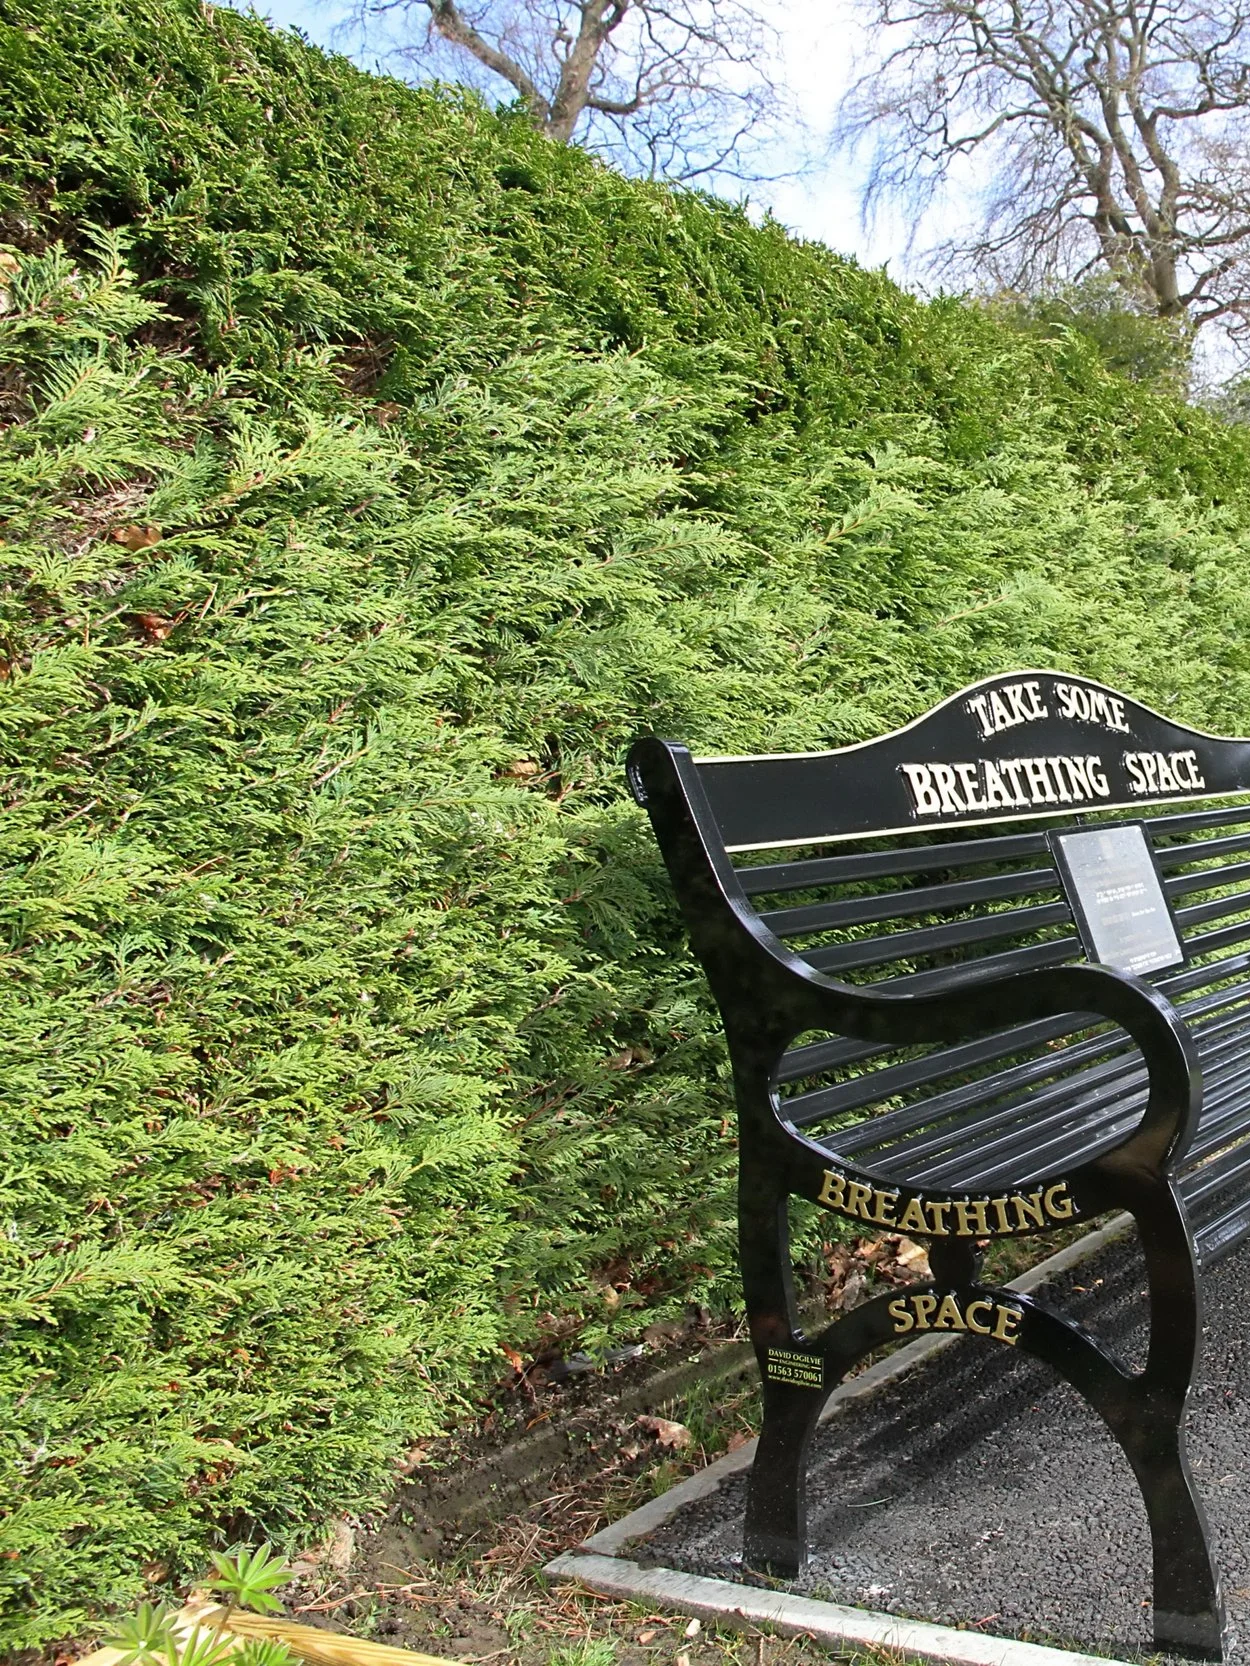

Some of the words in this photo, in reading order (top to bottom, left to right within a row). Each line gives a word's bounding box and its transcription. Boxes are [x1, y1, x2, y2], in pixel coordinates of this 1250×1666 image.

[968, 681, 1049, 738] TAKE
[1053, 682, 1130, 734] SOME
[901, 755, 1111, 815] BREATHING
[1123, 750, 1206, 793] SPACE
[818, 1169, 1074, 1236] BREATHING
[888, 1295, 1024, 1345] SPACE
[768, 1349, 791, 1360] DAVID
[793, 1353, 822, 1365] OGILVIE
[768, 1363, 792, 1376] 01563
[794, 1369, 822, 1382] 570061
